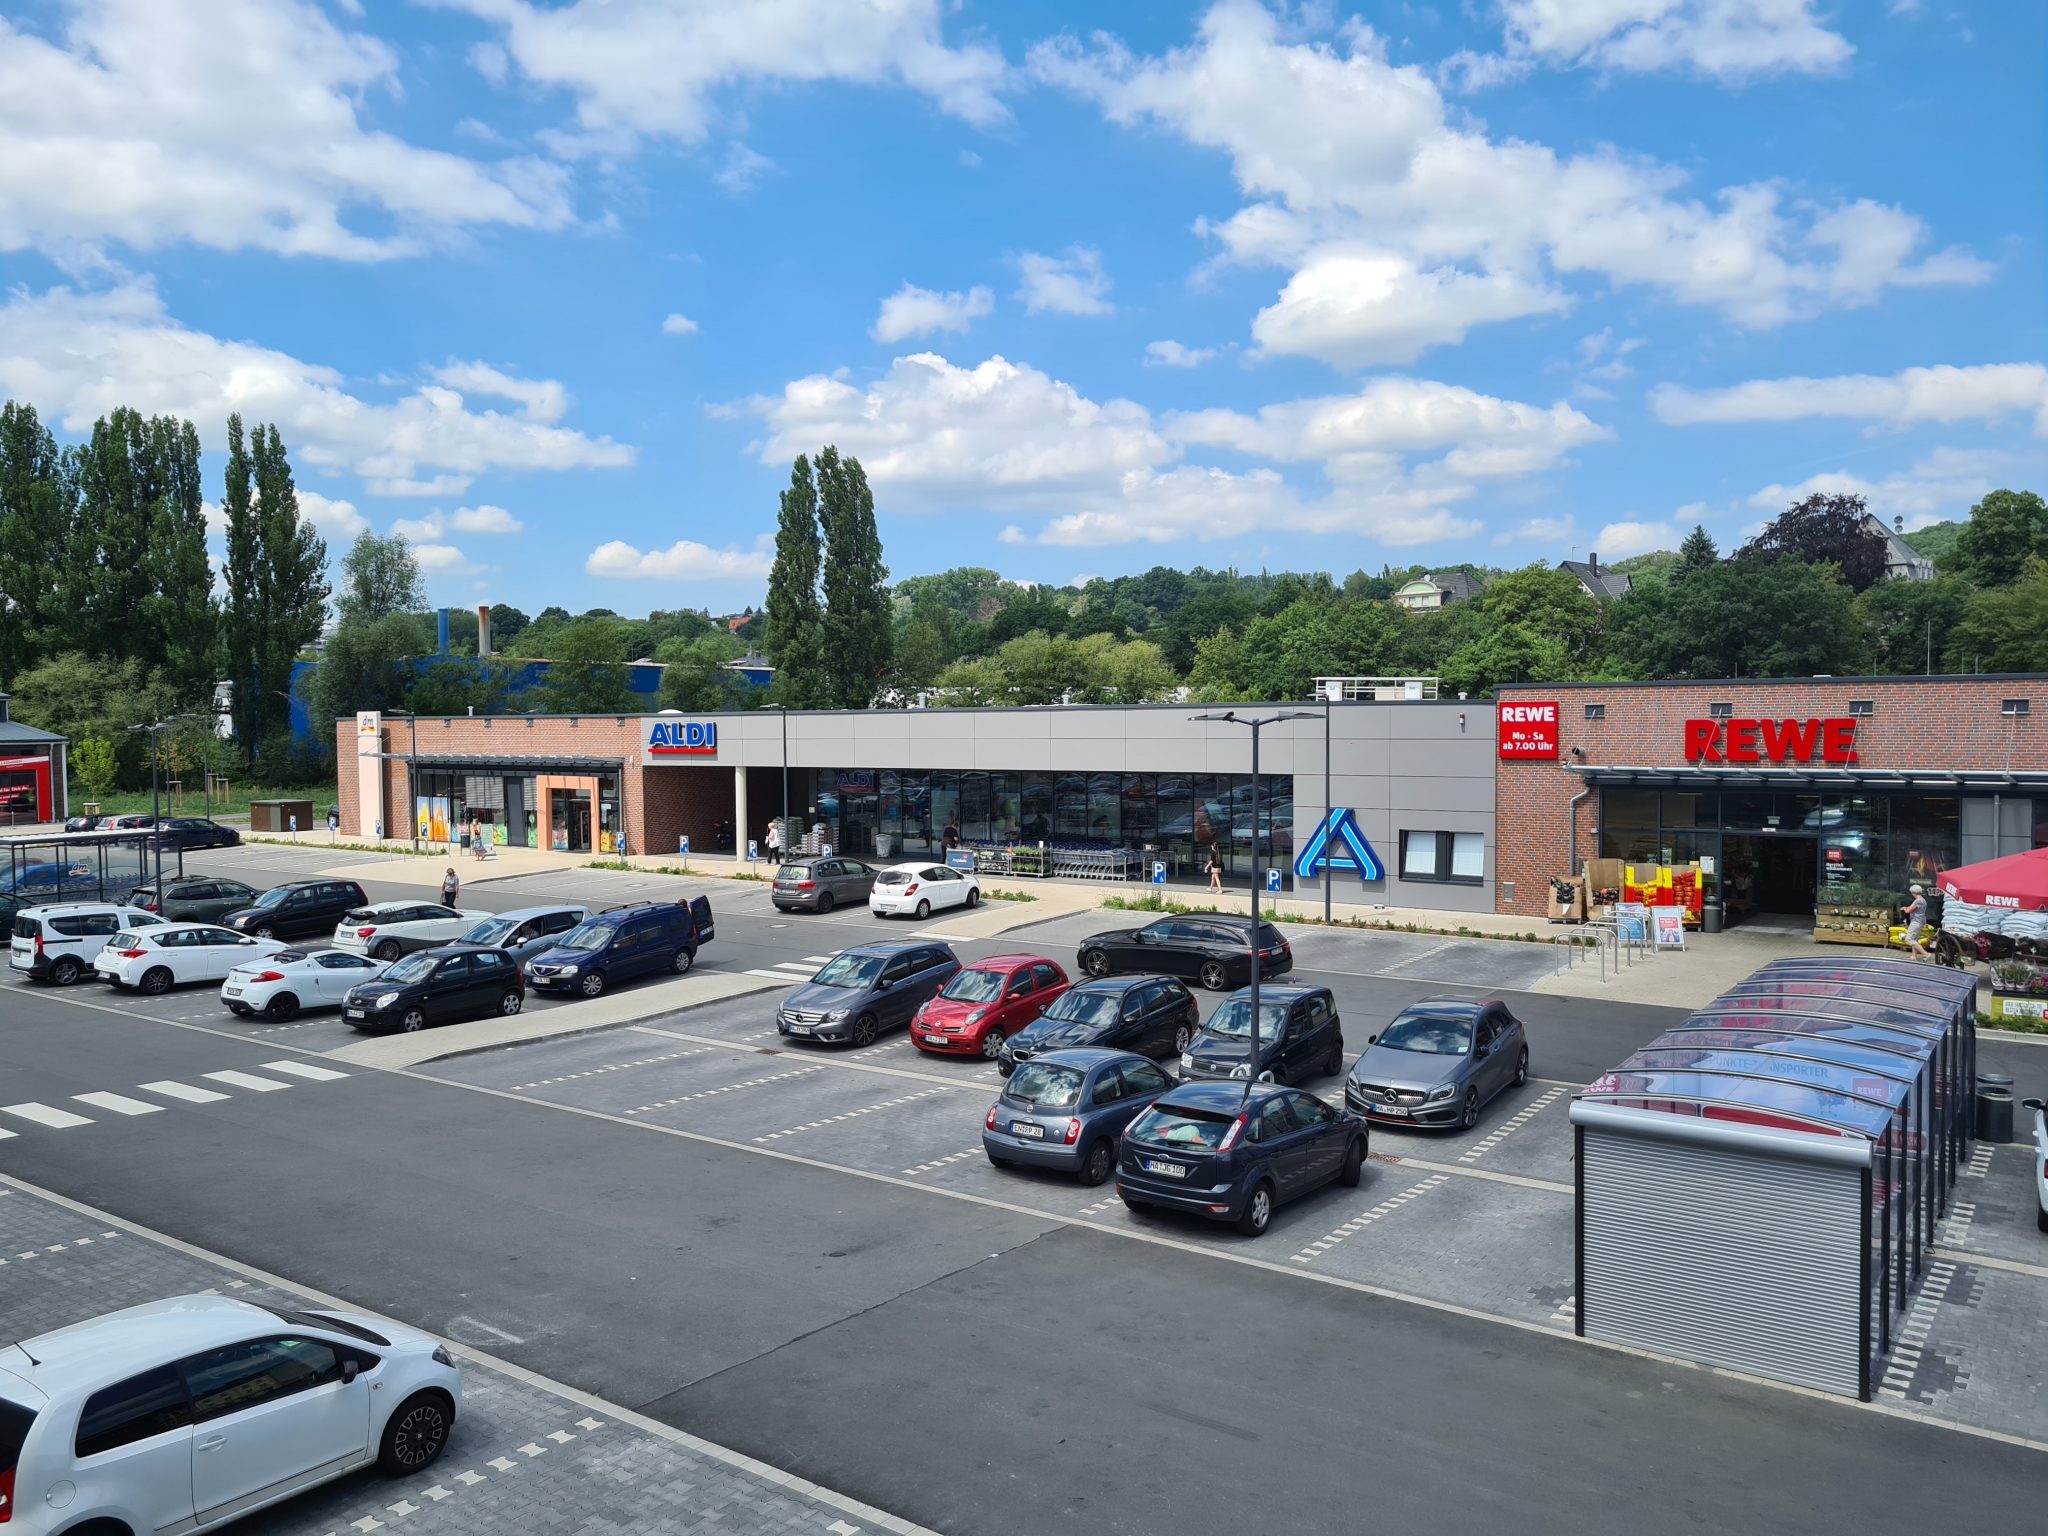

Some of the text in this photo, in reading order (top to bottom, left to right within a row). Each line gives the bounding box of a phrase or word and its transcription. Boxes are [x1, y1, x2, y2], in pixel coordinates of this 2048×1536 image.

[362, 715, 374, 726] dm
[1502, 706, 1554, 722] REWE
[649, 722, 715, 746] ALDI
[1512, 731, 1525, 740] Mo
[1533, 731, 1544, 740] Sa
[1685, 718, 1857, 761] REWE
[1502, 741, 1553, 751] ab 7.00 Uhr
[837, 772, 874, 786] ALDI
[1155, 863, 1163, 877] P
[1268, 870, 1279, 885] P
[1985, 895, 2019, 907] REWE
[1857, 1086, 1882, 1097] REWE
[1150, 1160, 1158, 1170] HA
[1172, 1165, 1185, 1175] 100
